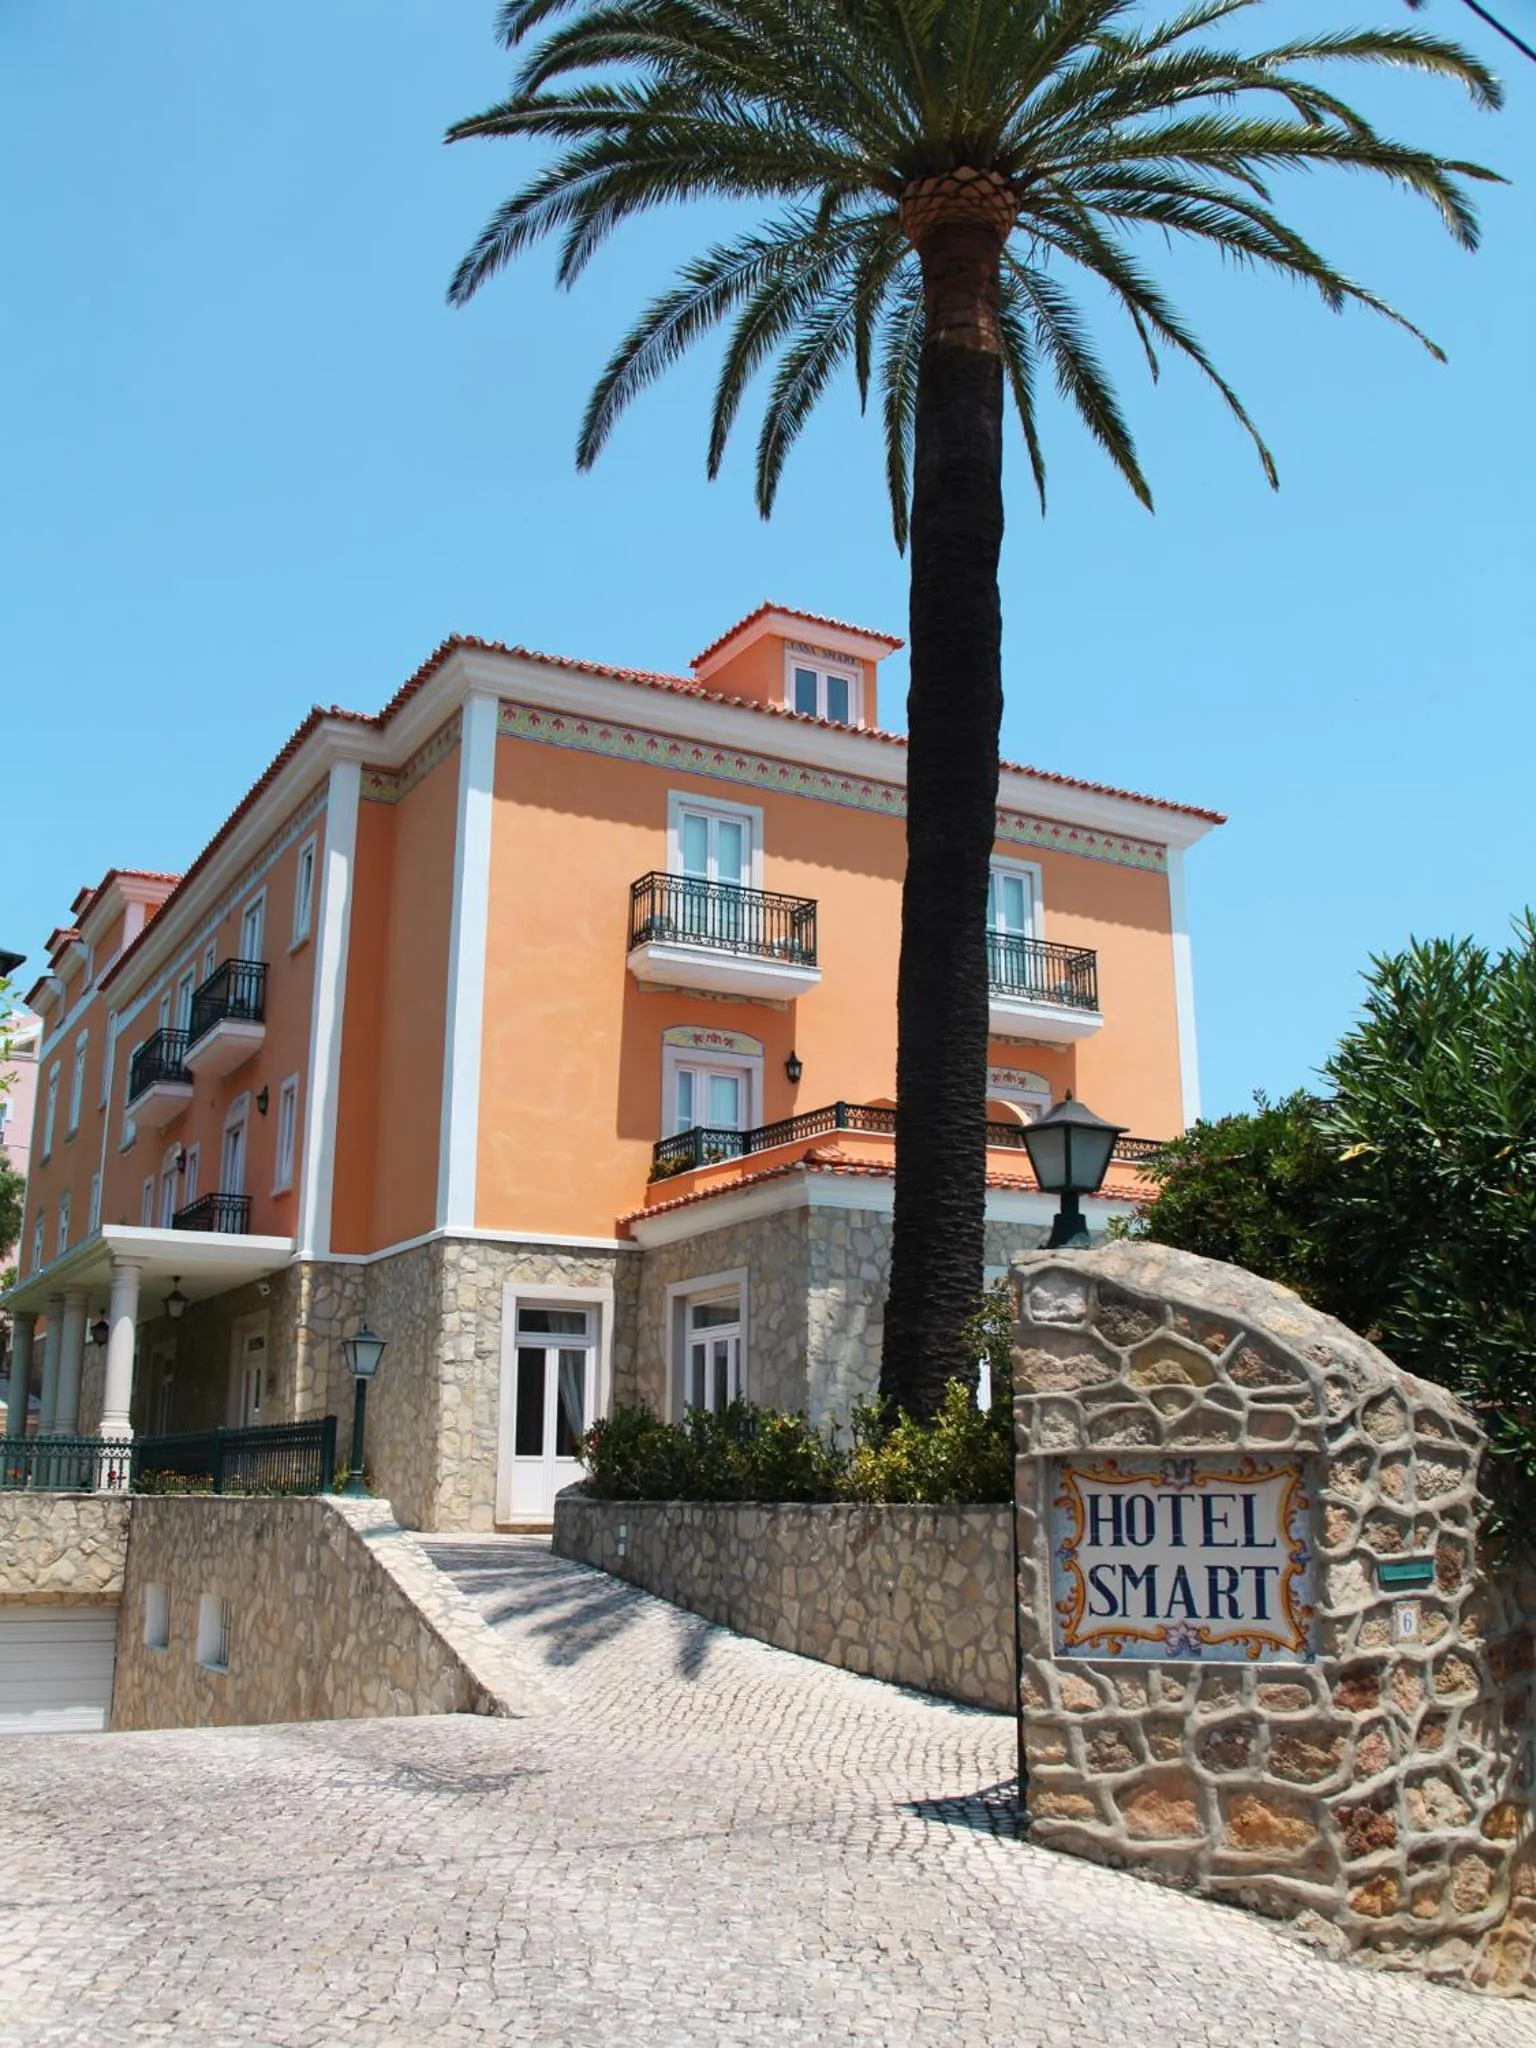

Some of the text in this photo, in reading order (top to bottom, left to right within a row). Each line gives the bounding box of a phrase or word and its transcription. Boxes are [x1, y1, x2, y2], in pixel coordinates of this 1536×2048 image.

[1086, 1493, 1277, 1548] HOTEL
[1087, 1563, 1279, 1620] SMART
[1403, 1611, 1413, 1634] 6
